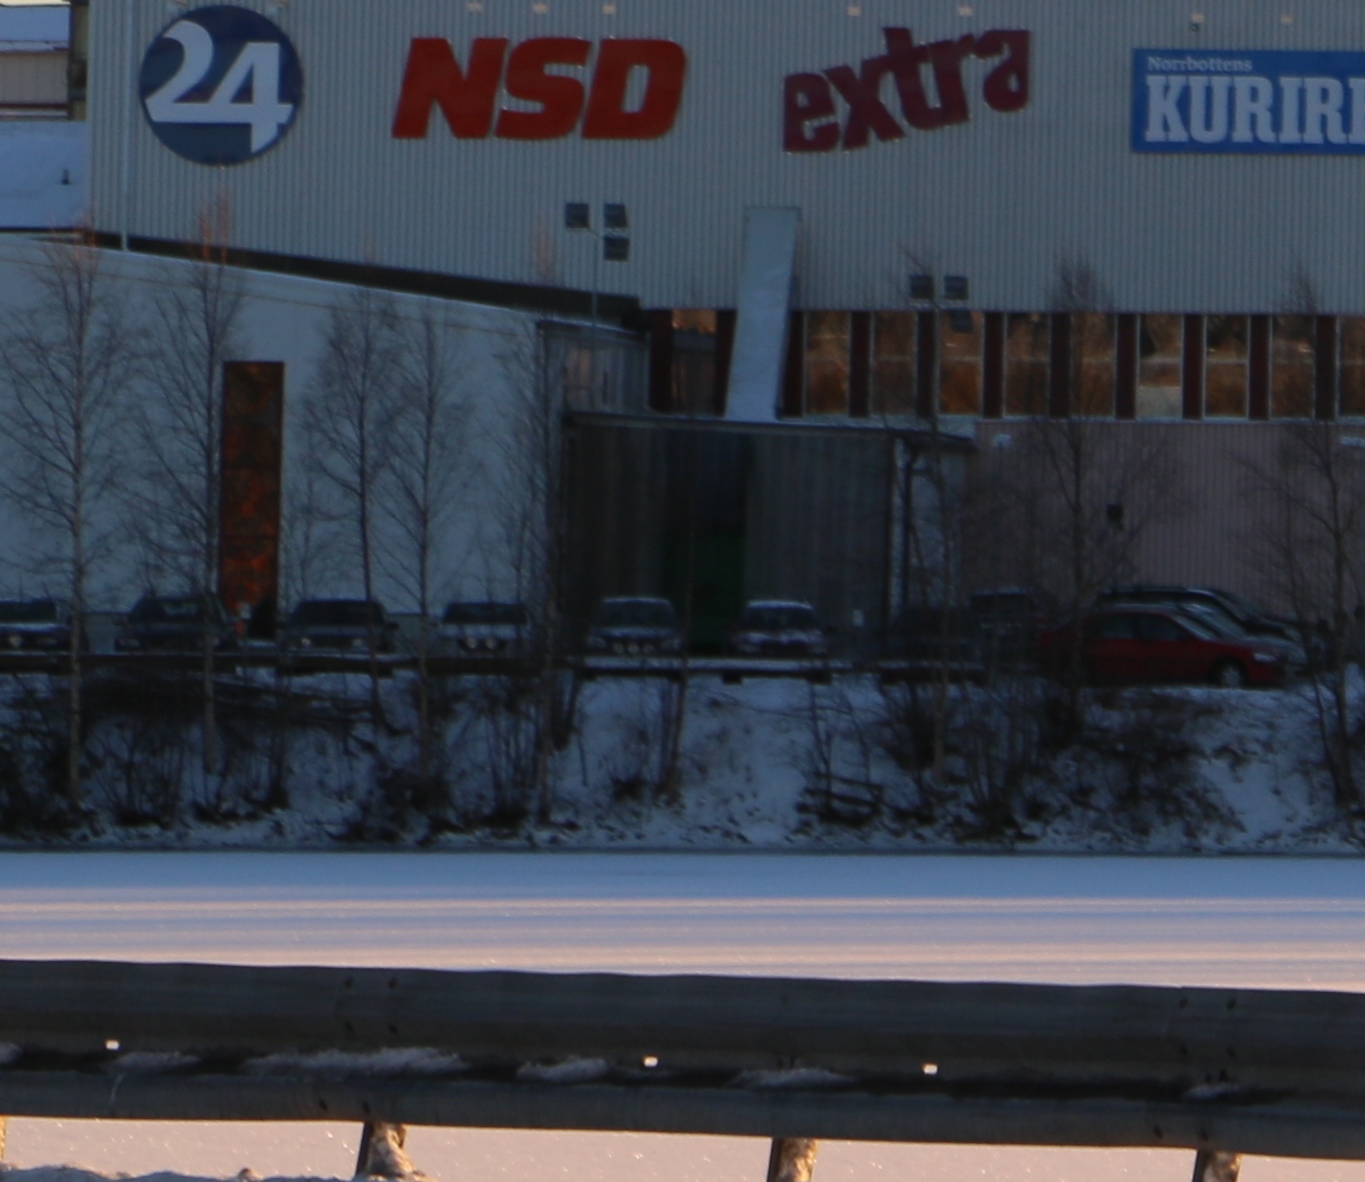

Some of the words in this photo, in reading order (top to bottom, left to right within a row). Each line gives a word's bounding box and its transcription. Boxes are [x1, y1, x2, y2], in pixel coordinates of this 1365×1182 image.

[144, 20, 296, 154] 24
[391, 36, 686, 140] NSD
[782, 26, 1031, 153] extra
[1147, 55, 1253, 71] Norrbottens
